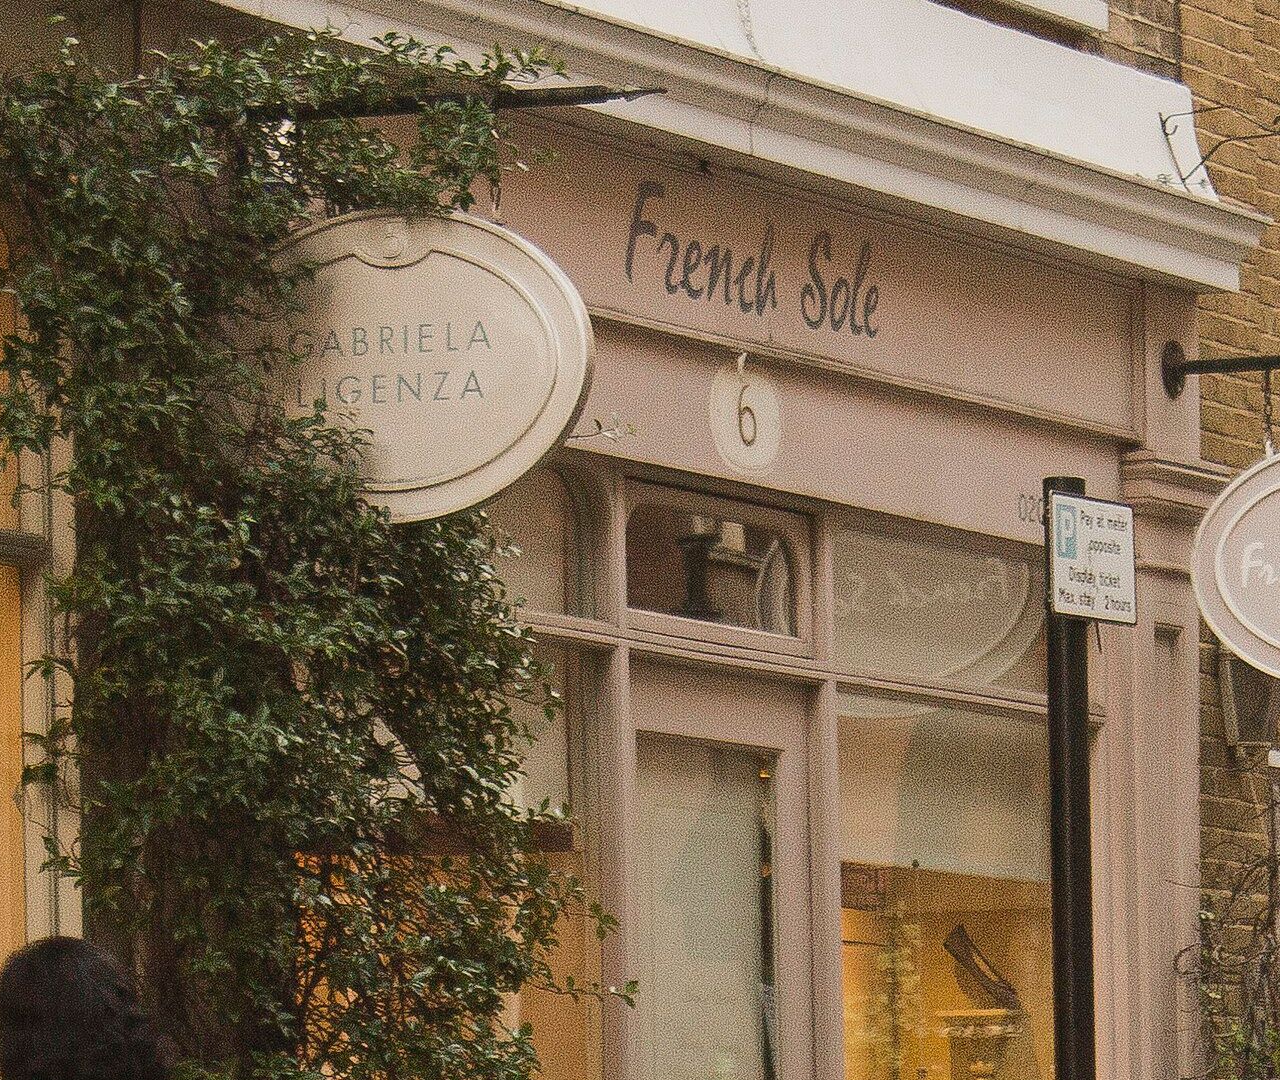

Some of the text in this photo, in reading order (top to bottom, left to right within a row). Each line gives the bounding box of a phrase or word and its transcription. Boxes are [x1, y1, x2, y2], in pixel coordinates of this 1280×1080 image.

[624, 180, 880, 338] French Sole
[287, 320, 492, 359] GABRIELA
[296, 370, 485, 408] LIGENZA
[737, 384, 758, 447] 6
[1060, 510, 1072, 554] P
[1080, 510, 1128, 532] Pay at meter
[1088, 539, 1122, 556] opposite
[1069, 566, 1121, 589] Display ticket
[1079, 591, 1095, 610] stay
[1110, 597, 1132, 613] hours
